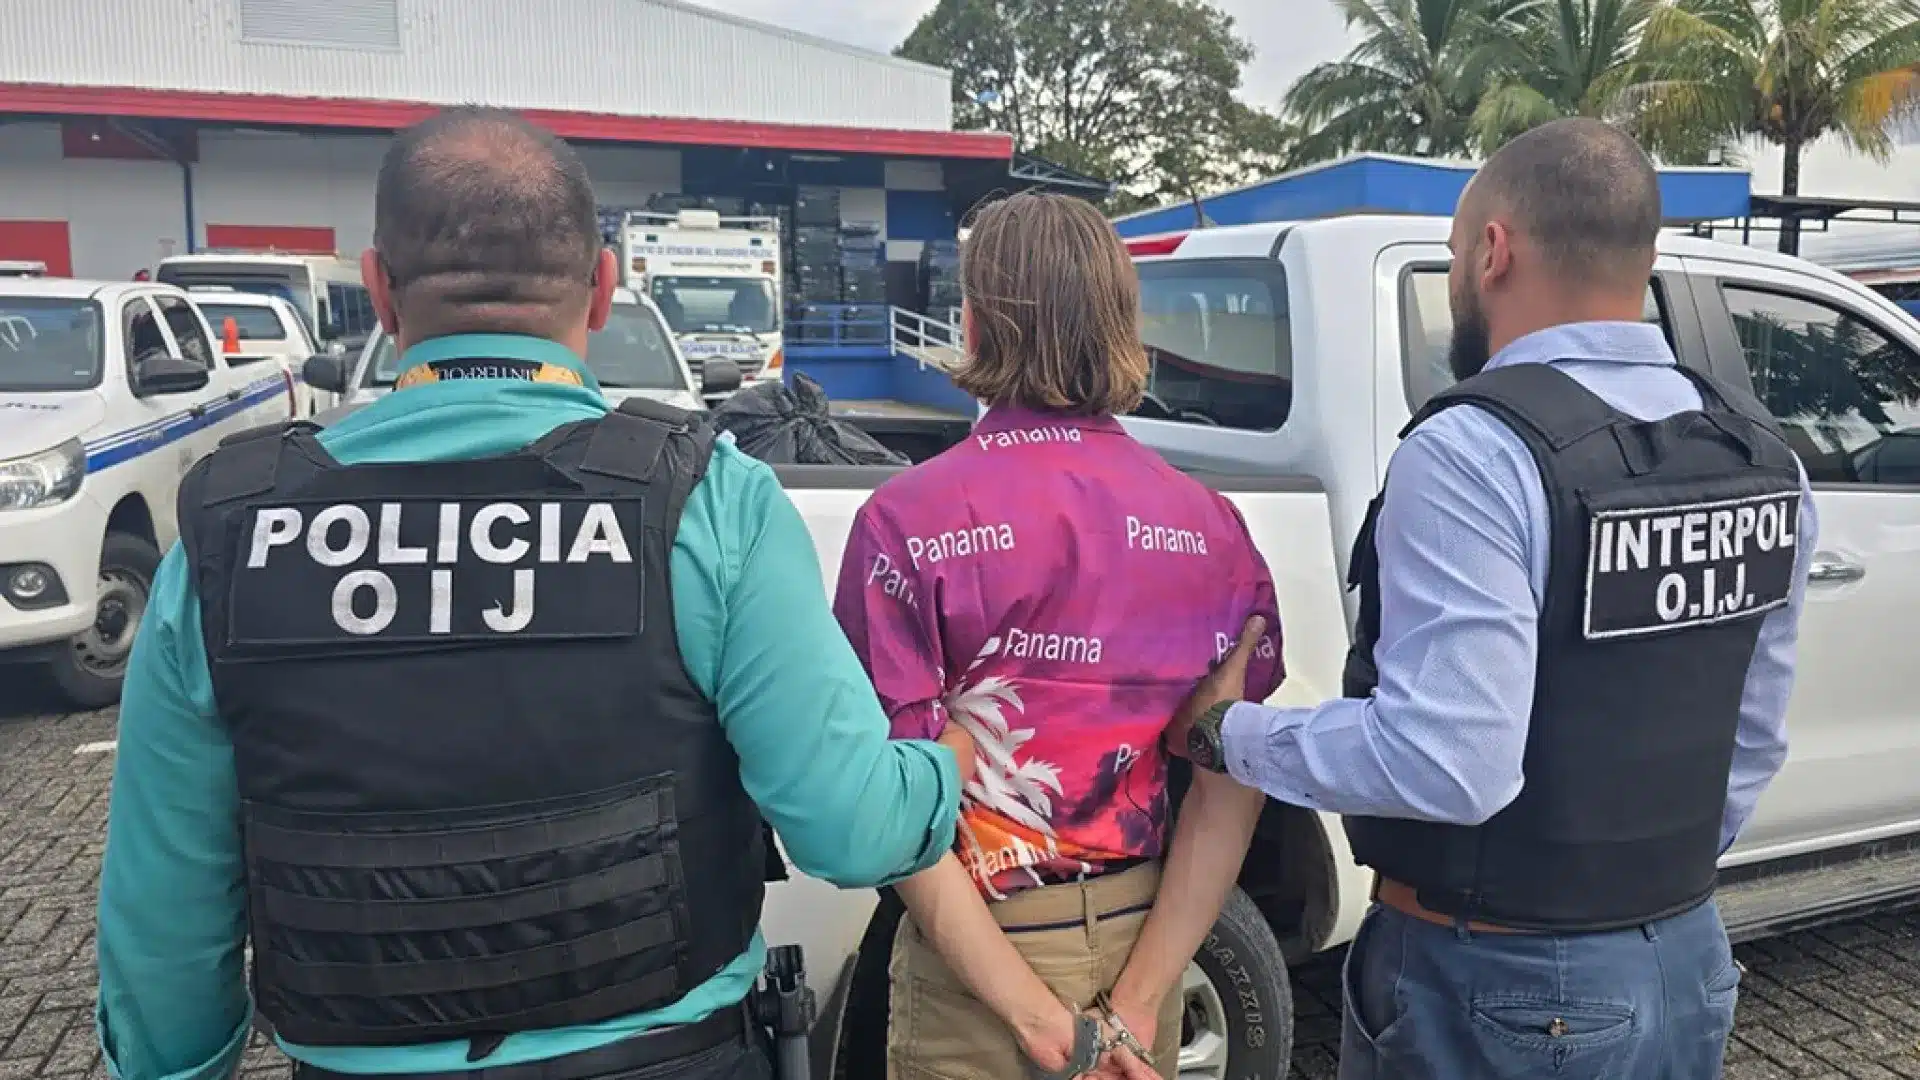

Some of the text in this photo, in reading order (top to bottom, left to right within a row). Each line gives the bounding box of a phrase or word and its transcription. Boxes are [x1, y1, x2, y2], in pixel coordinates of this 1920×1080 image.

[247, 502, 633, 568] POLICIA
[907, 522, 1016, 570] Panama
[1126, 516, 1208, 556] Panama
[1599, 501, 1794, 572] INTERPOL
